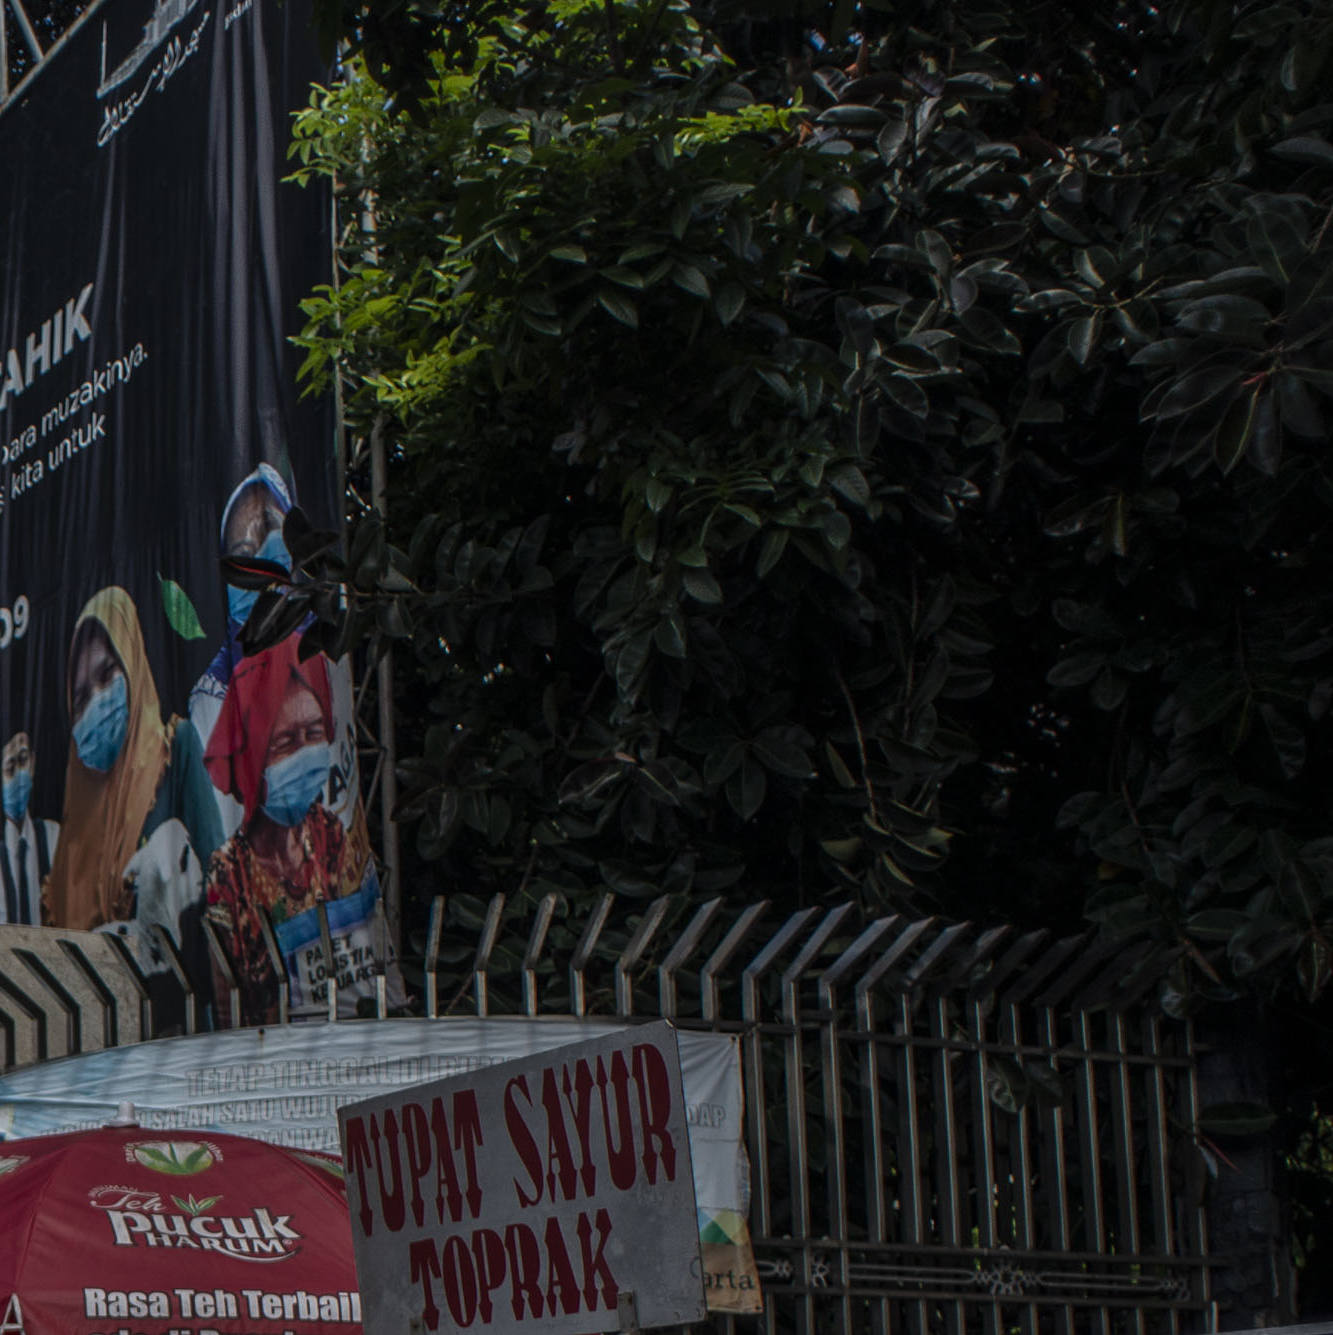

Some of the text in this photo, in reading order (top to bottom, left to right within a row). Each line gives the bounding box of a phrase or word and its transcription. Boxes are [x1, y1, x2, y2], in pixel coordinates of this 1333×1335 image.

[41, 341, 149, 438] muzakinya.
[10, 458, 44, 501] kita
[47, 411, 107, 472] untuk
[305, 931, 352, 966] PAET
[310, 963, 375, 1004] KEUARG
[185, 1065, 264, 1098] TETAP
[345, 1042, 677, 1237] TUPAT SAYUR
[145, 1231, 286, 1256] HARUM
[409, 1207, 620, 1330] TOPRAK
[83, 1287, 171, 1319] Rasa
[174, 1288, 239, 1319] Teh
